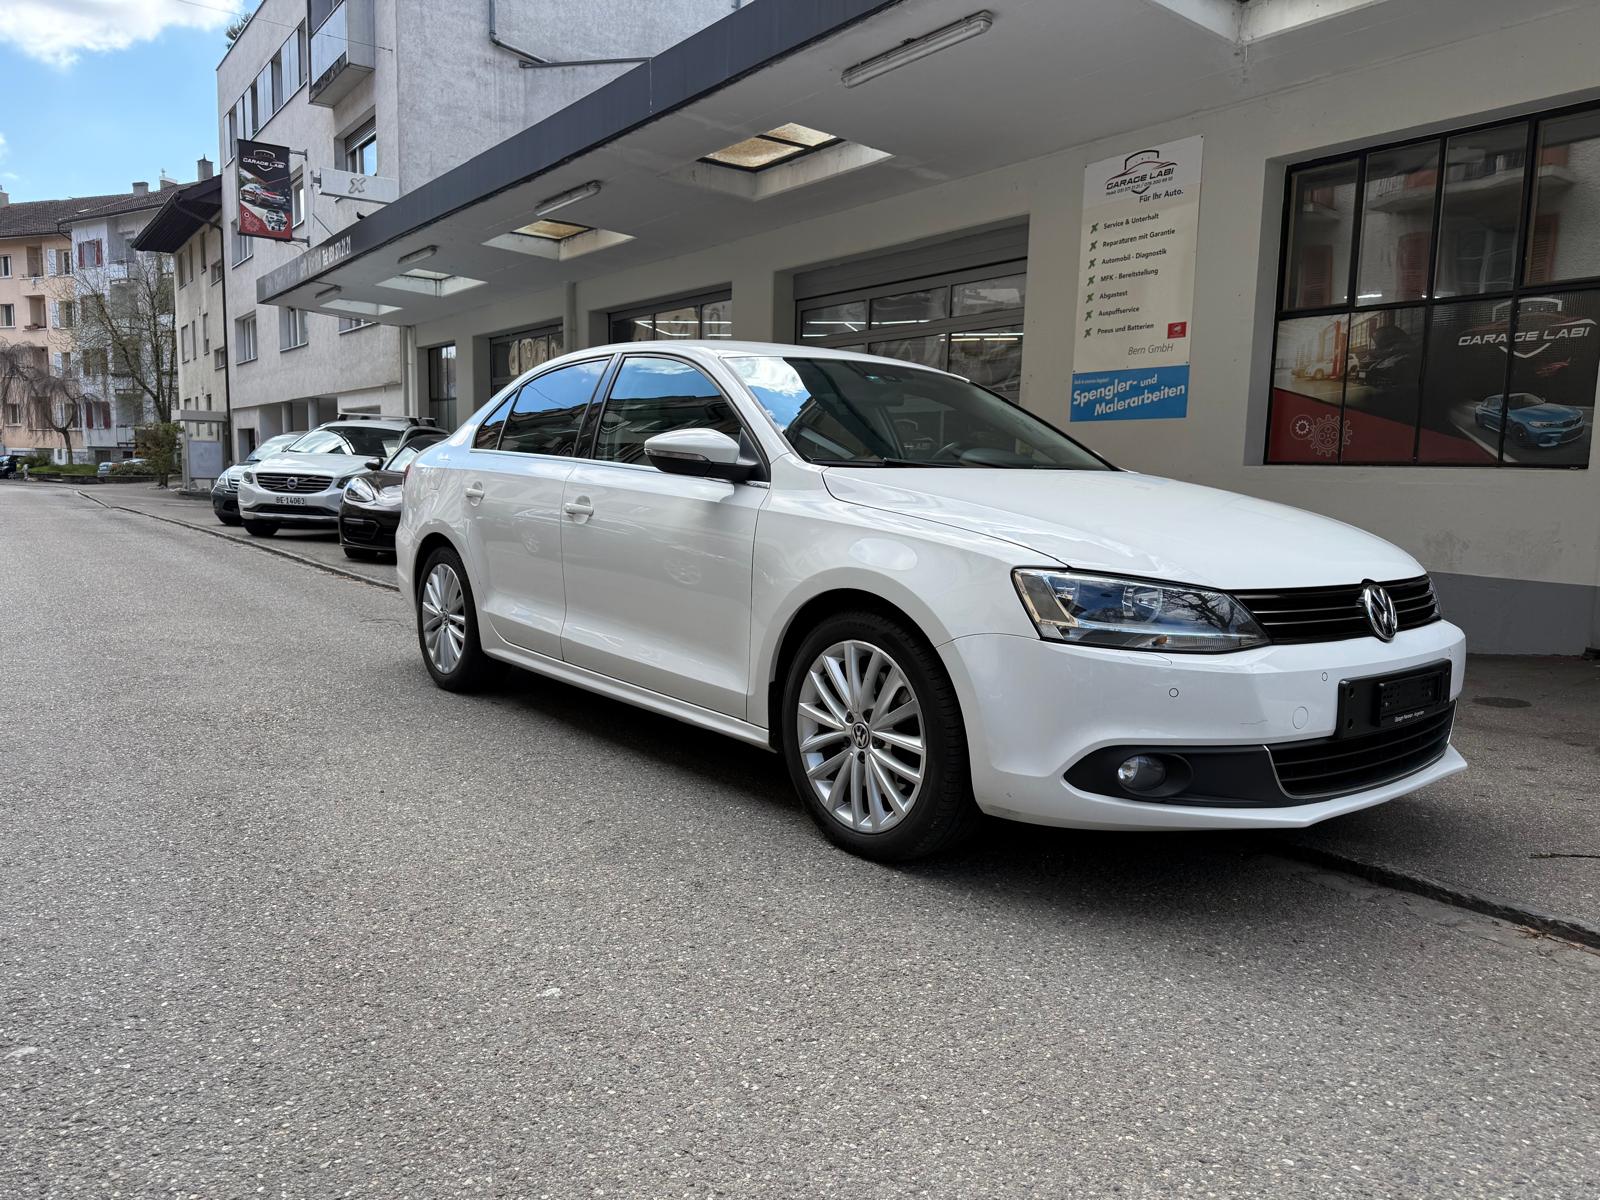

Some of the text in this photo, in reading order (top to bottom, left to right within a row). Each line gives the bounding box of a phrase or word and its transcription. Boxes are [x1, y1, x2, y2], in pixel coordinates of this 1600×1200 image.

[1106, 174, 1147, 190] GARAGE
[1149, 168, 1174, 179] LABI
[1139, 189, 1184, 203] Für Ihr Auto.
[1104, 221, 1124, 229] Service
[1131, 213, 1159, 223] Unterhalt
[1102, 236, 1137, 247] Reparaturen
[1149, 228, 1175, 238] Garantie
[1101, 254, 1131, 264] Automobil
[1135, 249, 1167, 259] Diagnostik
[1119, 268, 1158, 279] Bereitstellung
[1099, 290, 1128, 300] Abgastest
[1098, 306, 1140, 317] Auspuffservice
[1097, 327, 1114, 335] Pneus
[1127, 323, 1154, 331] Batterien
[1458, 326, 1591, 346] GARAGE LABI
[1128, 343, 1174, 356] Bern GmbH
[1073, 374, 1157, 407] Spengler- und
[1094, 384, 1185, 416] Malerarbeiten
